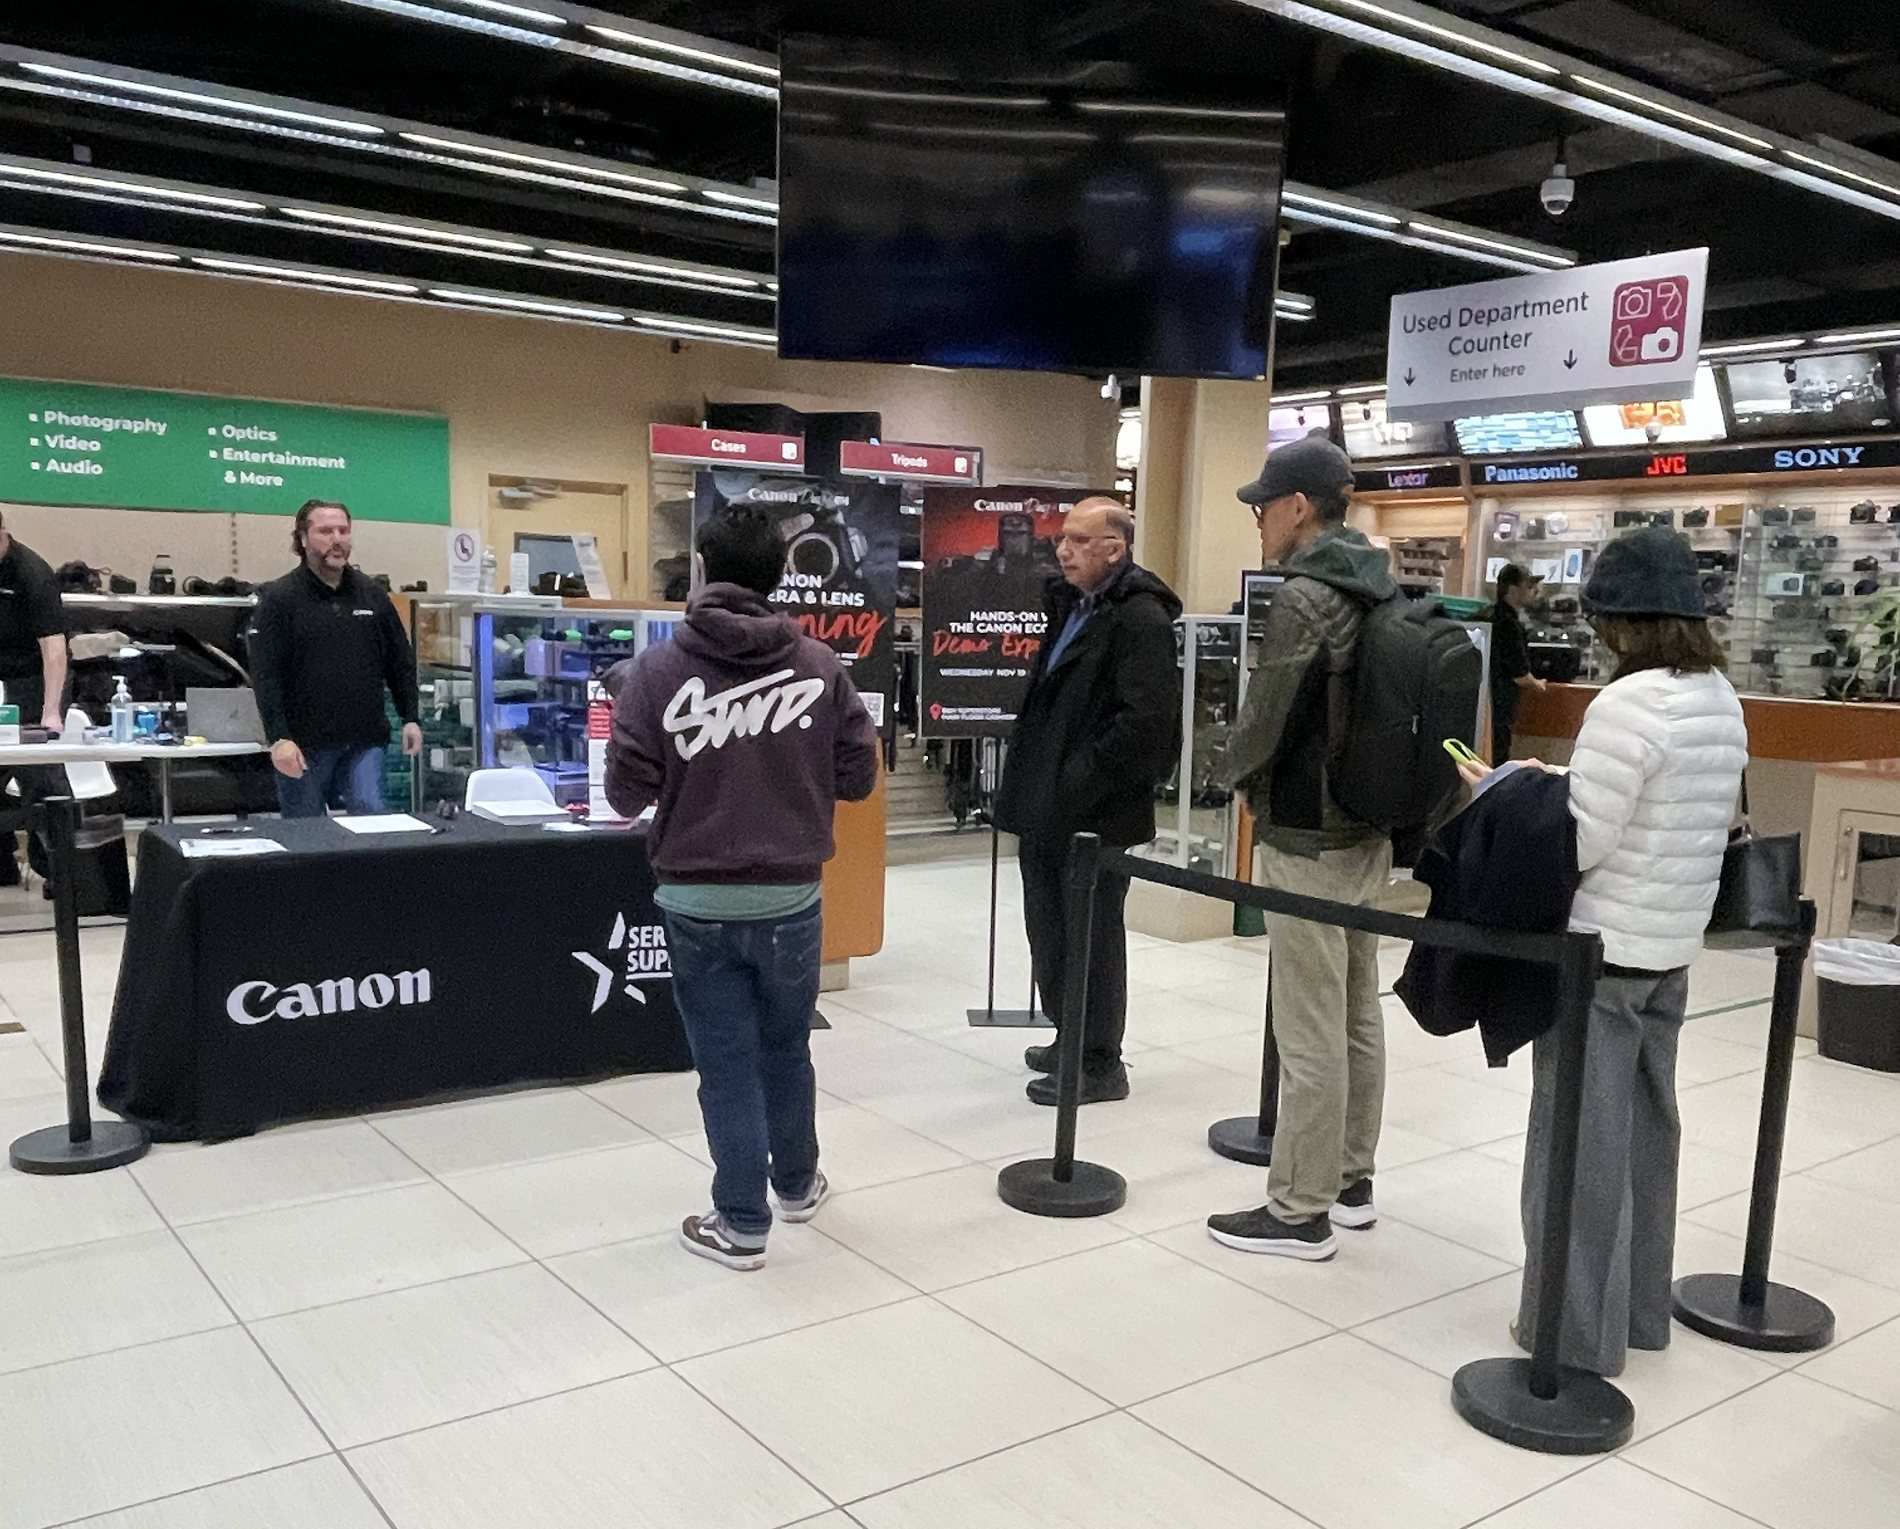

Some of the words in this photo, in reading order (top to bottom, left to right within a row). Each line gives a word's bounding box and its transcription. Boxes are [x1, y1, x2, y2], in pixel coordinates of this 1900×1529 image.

[1402, 307, 1452, 334] Used
[1458, 291, 1589, 328] Department
[1448, 331, 1533, 356] Counter
[1450, 366, 1489, 383] Enter
[1492, 363, 1526, 378] here
[44, 410, 168, 436] Photography
[222, 424, 278, 441] Optics
[44, 433, 101, 451] Video
[711, 438, 747, 453] Cases
[222, 447, 346, 469] Entertainment
[891, 452, 928, 468] Tripods
[1647, 455, 1688, 475] JVC
[1774, 446, 1865, 468] SONY
[46, 458, 104, 475] Audio
[1484, 462, 1579, 482] Panasonic
[224, 470, 237, 483] &
[239, 470, 284, 486] More
[1387, 472, 1431, 488] Lexar
[747, 487, 798, 503] Canon
[974, 499, 1024, 512] Canon
[780, 573, 822, 588] NON
[804, 590, 817, 604] &
[821, 591, 865, 607] LENS
[970, 611, 1038, 622] HANDS-ON
[949, 622, 974, 633] THE
[976, 622, 1022, 633] CANON
[627, 949, 673, 972] SUP
[226, 967, 431, 1025] Canon
